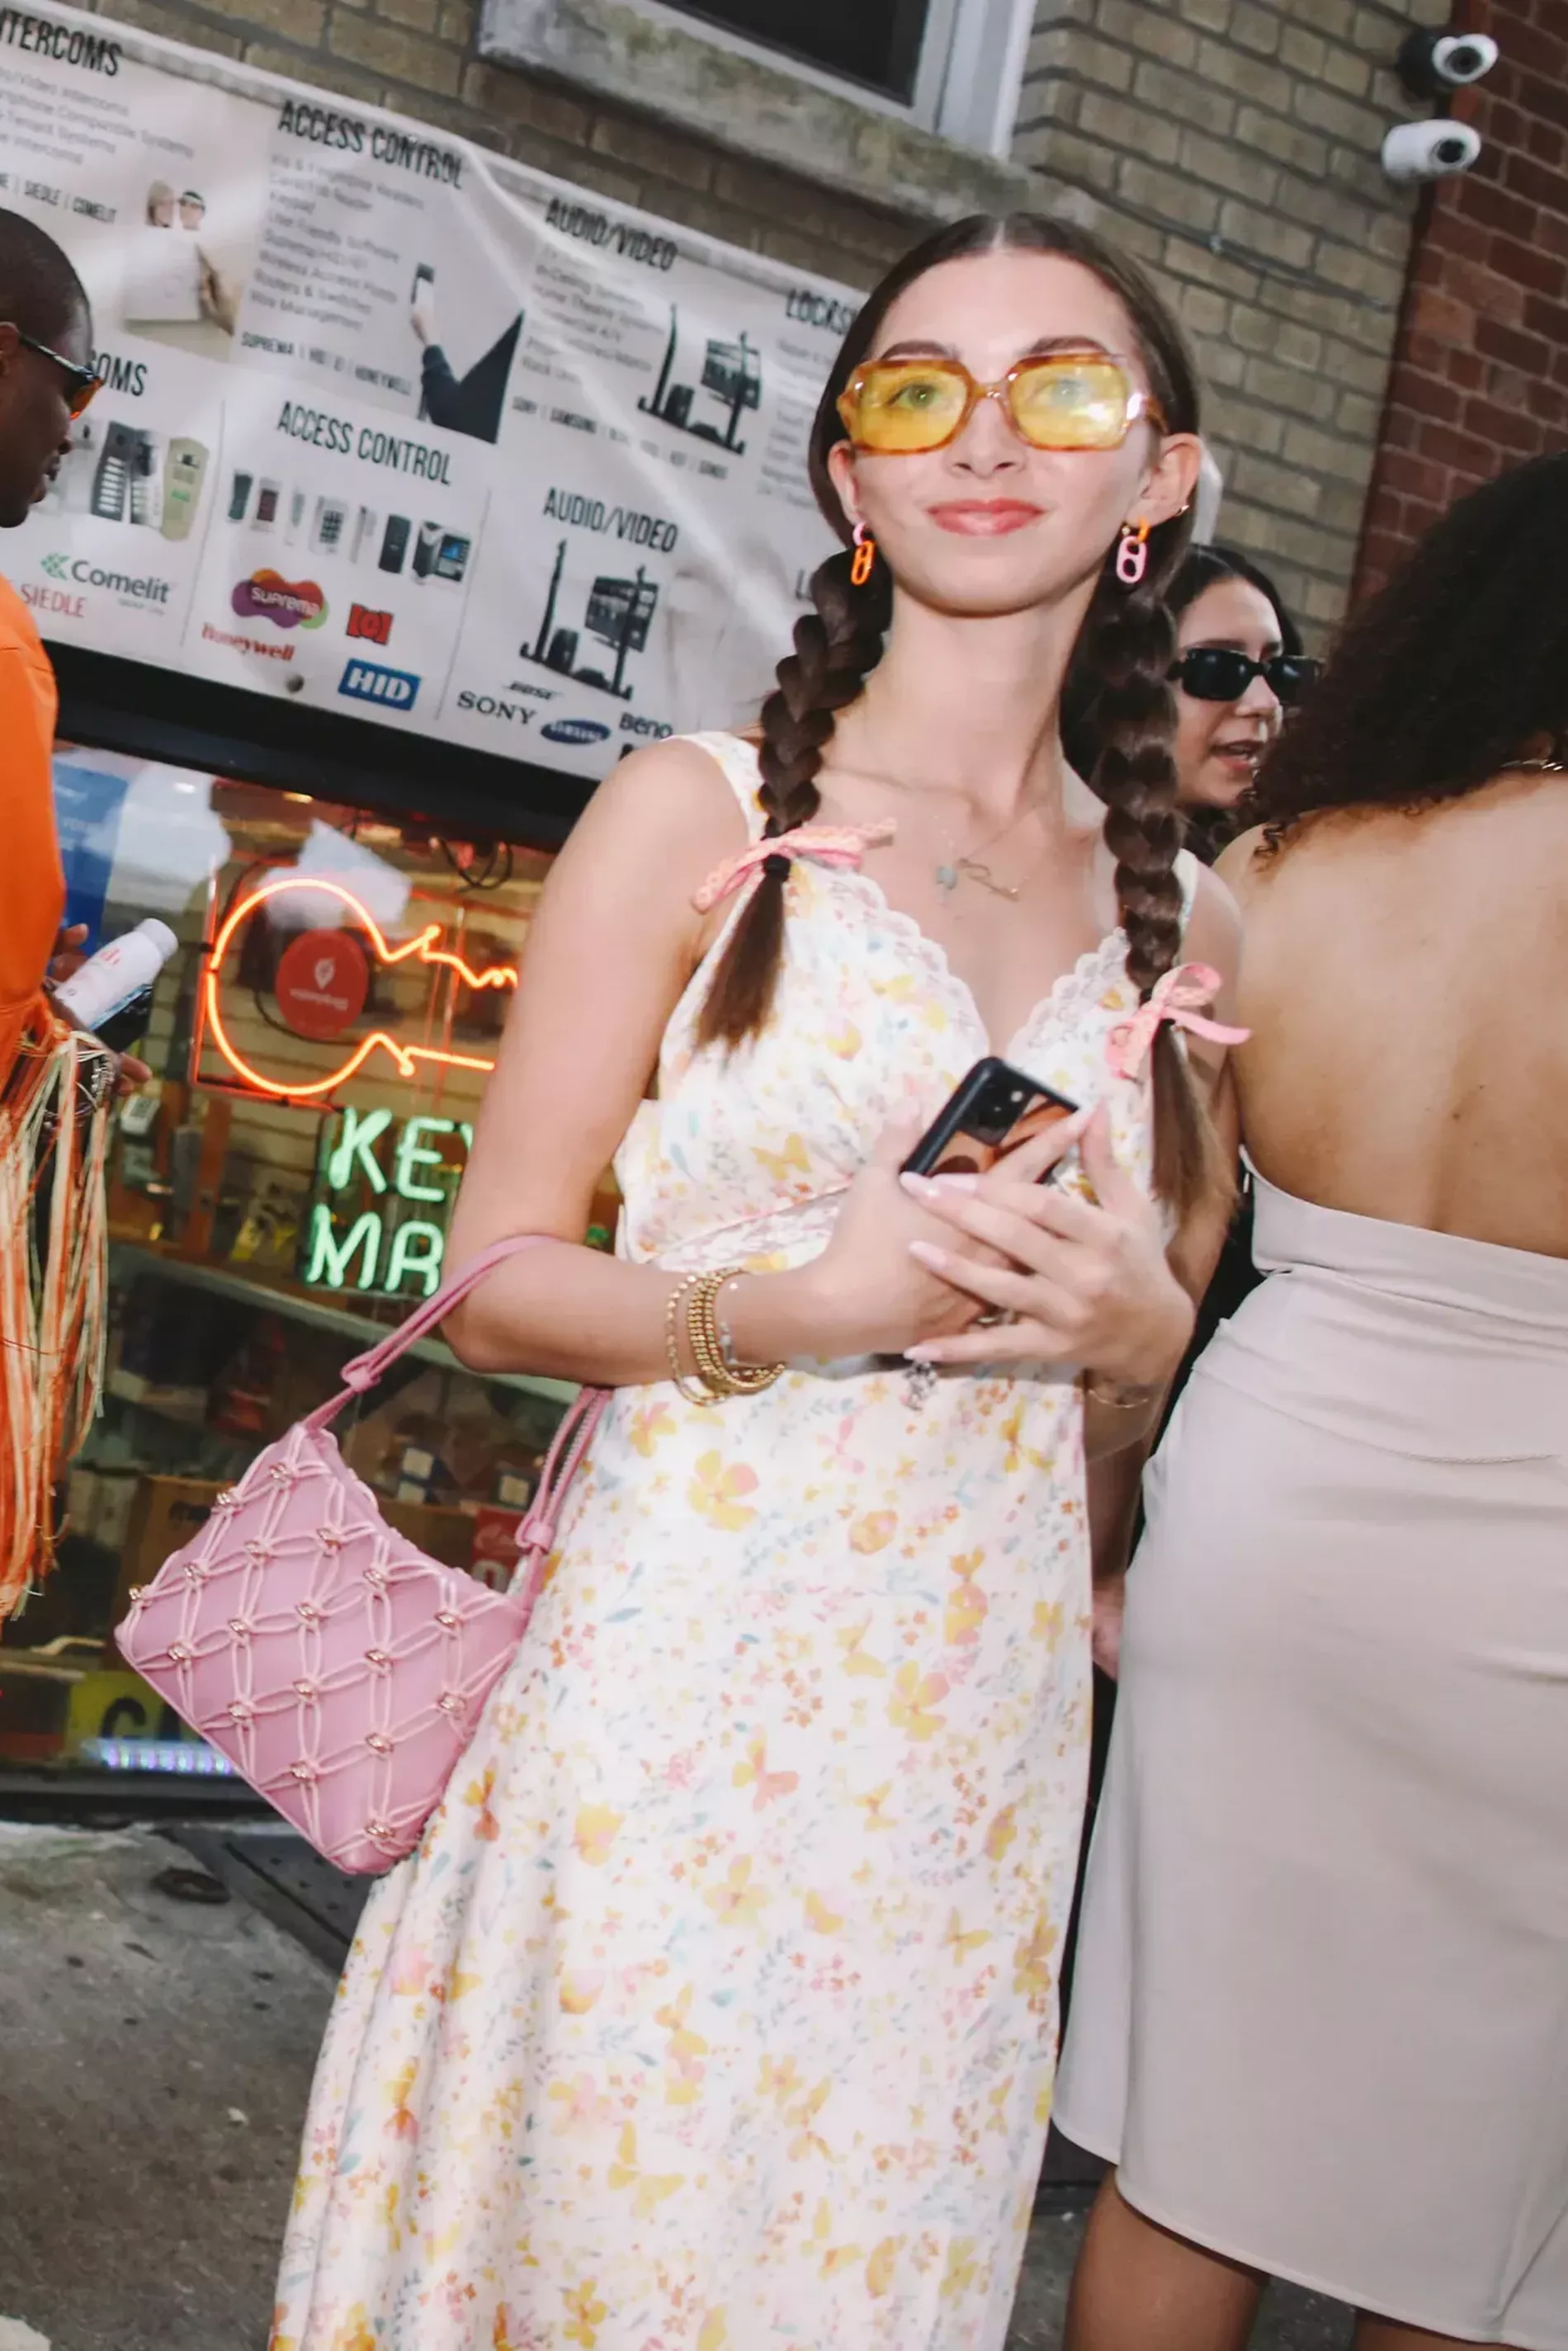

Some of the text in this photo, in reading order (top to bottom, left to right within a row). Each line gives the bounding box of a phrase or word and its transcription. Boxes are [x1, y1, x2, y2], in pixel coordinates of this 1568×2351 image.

[277, 99, 366, 153] ACCESS
[371, 126, 462, 190] CONTROL
[545, 197, 678, 271] AUDIO/VIDEO
[277, 401, 451, 485] ACCESS CONTROL
[543, 487, 678, 553] AUDIO/VIDEO
[20, 583, 87, 618] SIEDLE
[71, 559, 170, 604] Comelit
[347, 666, 411, 701] HID
[456, 690, 536, 725] SONY
